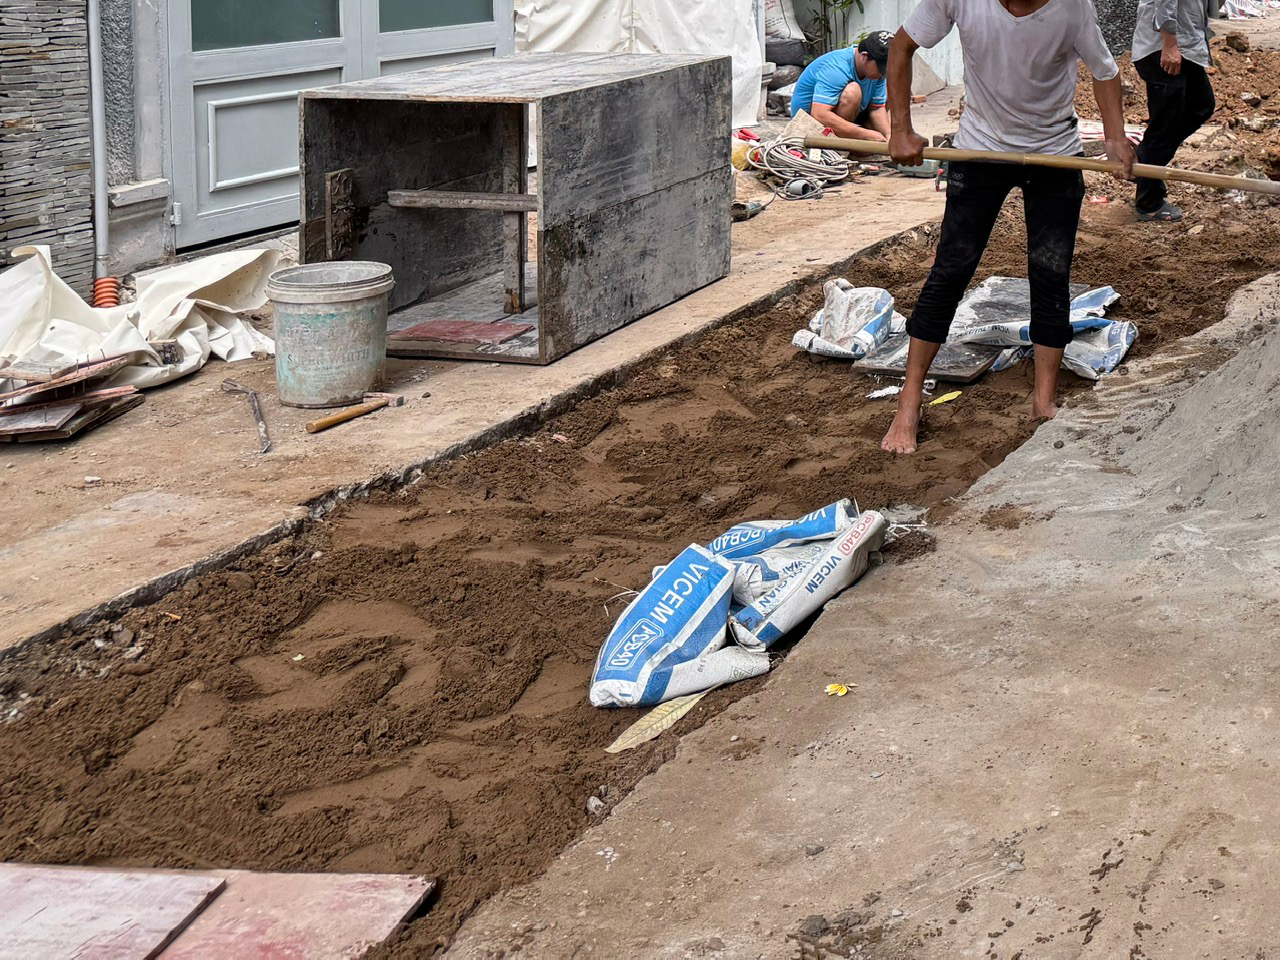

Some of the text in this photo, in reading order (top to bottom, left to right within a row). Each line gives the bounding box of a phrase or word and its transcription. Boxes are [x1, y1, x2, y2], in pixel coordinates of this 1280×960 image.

[839, 514, 874, 552] PCB40
[650, 563, 709, 624] VICEM
[805, 555, 842, 594] VICEM
